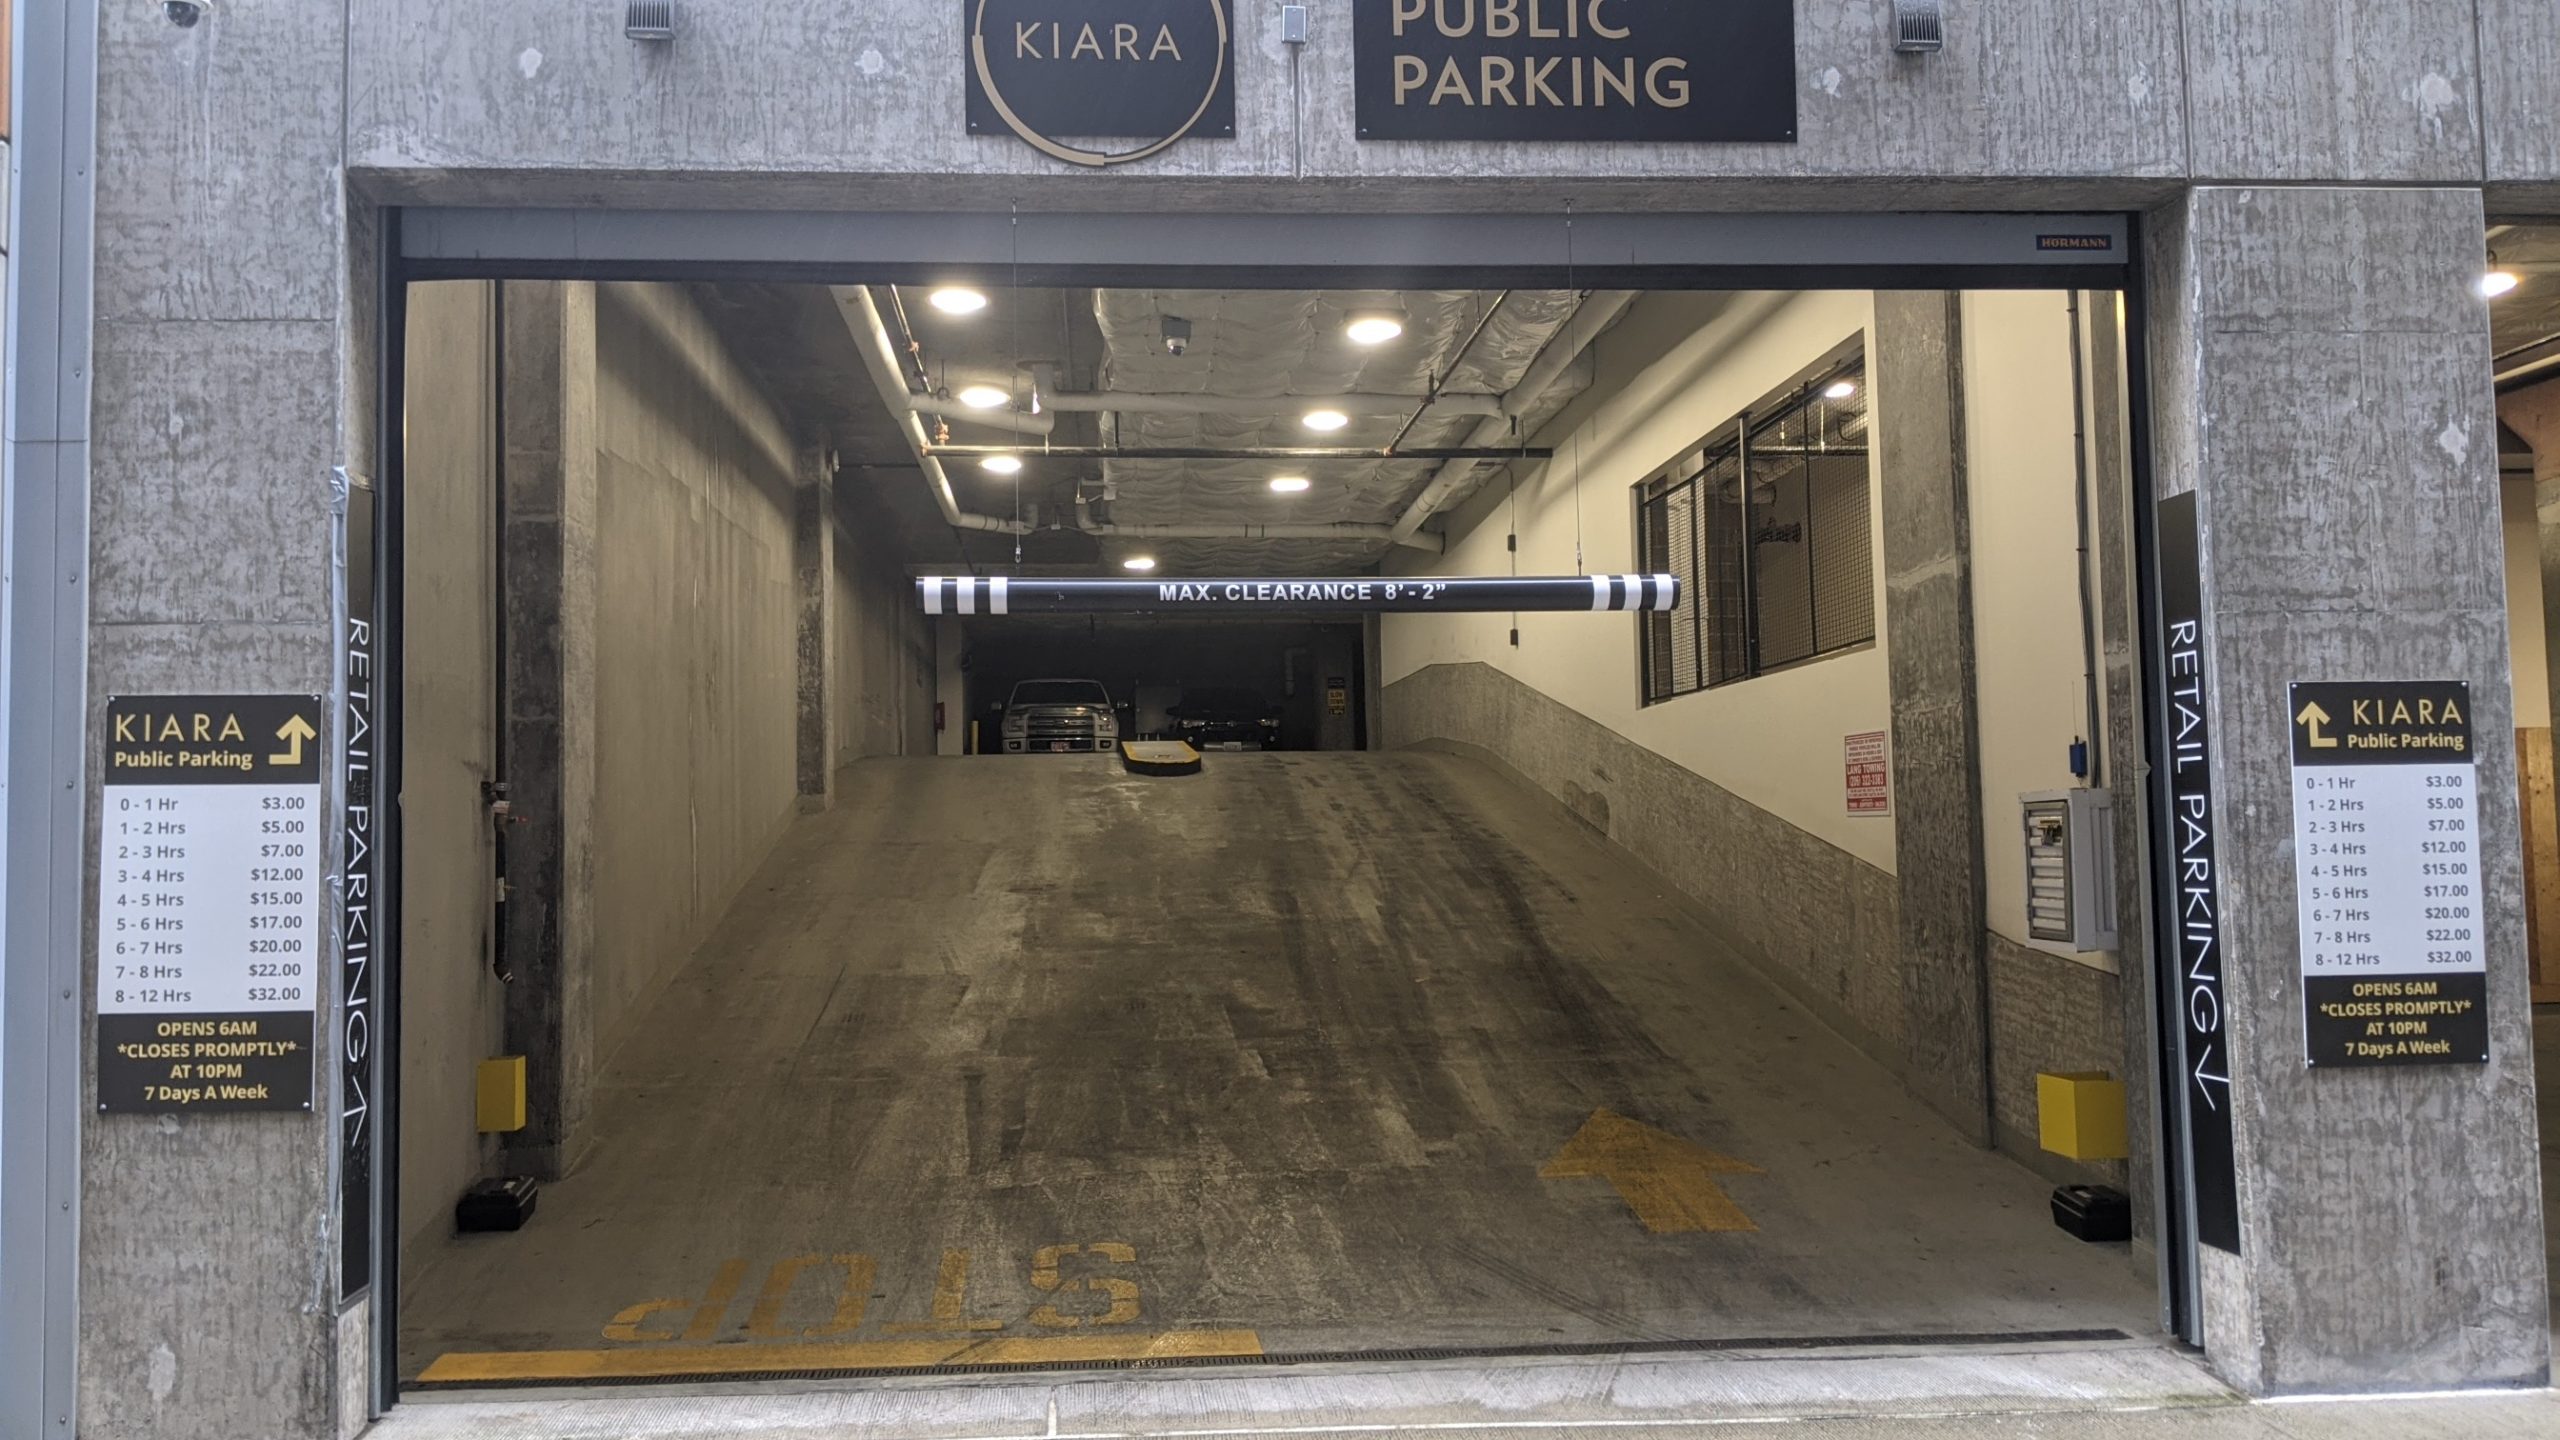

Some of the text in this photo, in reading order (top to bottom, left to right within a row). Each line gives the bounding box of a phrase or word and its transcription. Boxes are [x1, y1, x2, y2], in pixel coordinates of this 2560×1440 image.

[1392, 0, 1631, 39] PUBLIC
[1016, 22, 1182, 61] KIARA
[1394, 55, 1690, 108] PARKING
[1159, 584, 1217, 601] MAX.
[1225, 584, 1372, 600] CLEARANCE
[2353, 699, 2462, 725] KIARA
[116, 714, 244, 742] KIARA
[2348, 733, 2464, 751] Public Parking
[115, 750, 252, 770] Public Parking
[2307, 778, 2314, 789] 0
[2328, 777, 2333, 789] 1
[2339, 777, 2355, 789] Hr
[2426, 776, 2462, 787] $3.00
[121, 798, 129, 811] 0
[145, 798, 151, 810] 1
[159, 798, 178, 810] Hr
[263, 797, 304, 810] $3.00
[2309, 800, 2314, 811] 1
[2328, 799, 2336, 811] 2
[2340, 799, 2364, 810] Hrs
[2427, 797, 2463, 809] $5.00
[121, 822, 127, 834] 1
[143, 822, 152, 834] 2
[158, 822, 185, 834] Hrs
[262, 821, 304, 833] $5.00
[2170, 619, 2218, 1034] RETAIL PARKING
[2309, 822, 2317, 833] 2
[2329, 821, 2337, 833] 3
[2341, 821, 2365, 832] Hrs
[2429, 819, 2464, 831] $7.00
[346, 618, 370, 1063] RETAIL PARKING
[2310, 843, 2318, 855] 3
[2330, 843, 2338, 854] 4
[2342, 843, 2366, 854] Hrs
[2422, 841, 2466, 853] $12.00
[119, 846, 128, 858] 2
[143, 846, 152, 858] 3
[158, 846, 184, 858] Hrs
[261, 844, 303, 857] $7.00
[118, 870, 127, 883] 3
[142, 870, 151, 882] 4
[157, 870, 184, 882] Hrs
[251, 868, 303, 881] $12.00
[2311, 866, 2319, 877] 4
[2332, 865, 2339, 877] 5
[2344, 865, 2367, 876] Hrs
[2423, 863, 2467, 875] $15.00
[117, 894, 127, 906] 4
[142, 894, 150, 906] 5
[156, 894, 183, 906] Hrs
[251, 892, 302, 905] $15.00
[2313, 888, 2320, 899] 5
[2332, 887, 2340, 899] 6
[2345, 887, 2368, 898] Hrs
[2424, 885, 2468, 897] $17.00
[2313, 909, 2321, 921] 6
[2333, 909, 2341, 921] 7
[2346, 909, 2369, 920] Hrs
[2425, 907, 2469, 919] $20.00
[117, 918, 126, 931] 5
[141, 917, 150, 930] 6
[156, 918, 183, 930] Hrs
[250, 916, 302, 929] $17.00
[2314, 932, 2322, 944] 7
[2335, 931, 2342, 943] 8
[2347, 931, 2371, 943] Hrs
[2427, 929, 2470, 941] $22.00
[116, 942, 125, 954] 6
[140, 942, 149, 954] 7
[155, 942, 182, 954] Hrs
[250, 940, 301, 953] $20.00
[2316, 954, 2323, 966] 8
[2336, 953, 2352, 965] 12
[2356, 953, 2380, 965] Hrs
[2428, 951, 2472, 963] $32.00
[116, 966, 125, 978] 7
[140, 966, 148, 978] 8
[155, 966, 182, 978] Hrs
[249, 963, 301, 976] $22.00
[116, 990, 124, 1003] 8
[140, 990, 158, 1002] 12
[164, 989, 191, 1002] Hrs
[249, 987, 300, 1000] $32.00
[2353, 982, 2437, 996] OPENS 6AM
[158, 1021, 256, 1036] OPENS 6AM
[2366, 1021, 2427, 1035] AT 10PM
[2345, 1040, 2450, 1058] 7 Days A Week
[170, 1064, 241, 1078] AT 10PM
[145, 1084, 267, 1104] 7 Days A Week
[601, 1241, 1142, 1342] STOP
